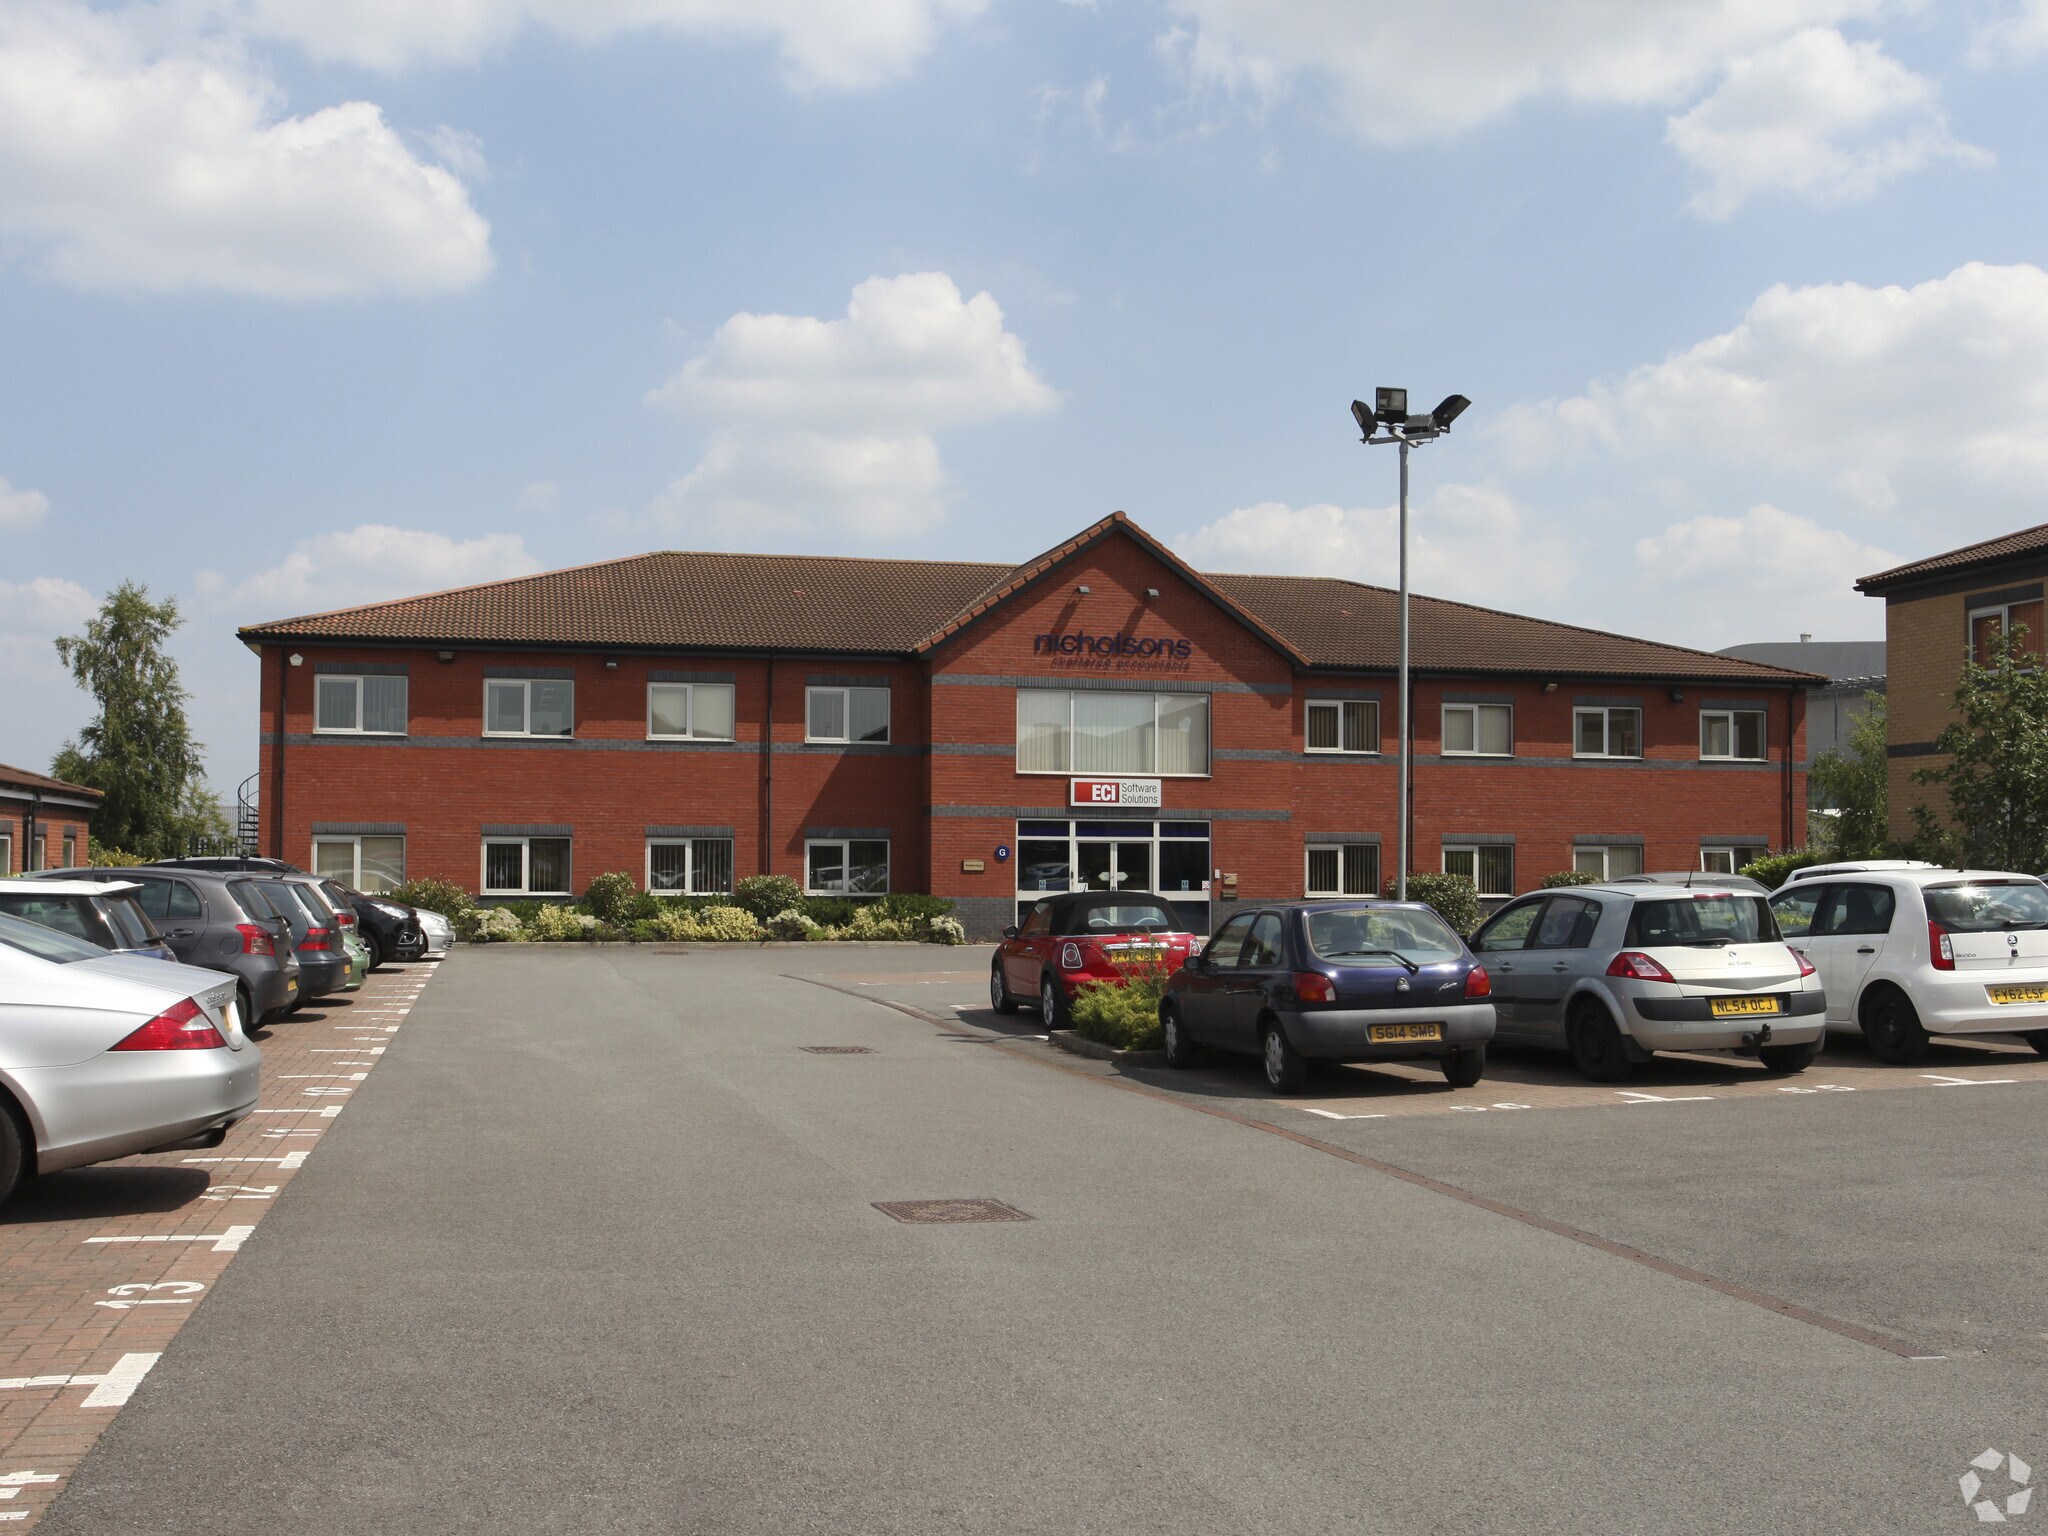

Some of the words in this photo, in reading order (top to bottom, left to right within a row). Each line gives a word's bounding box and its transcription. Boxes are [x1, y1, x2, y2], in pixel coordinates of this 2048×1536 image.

[1036, 630, 1192, 658] nicholsons
[1121, 782, 1157, 793] Software
[1121, 793, 1158, 804] Solutions
[999, 848, 1006, 857] G
[1994, 988, 2023, 1001] FY62
[2025, 987, 2045, 999] CSF
[1716, 999, 1748, 1013] NL54
[1750, 998, 1773, 1011] OCJ
[1375, 1026, 1406, 1039] S614
[1409, 1024, 1436, 1038] SMB
[94, 1281, 205, 1309] 13
